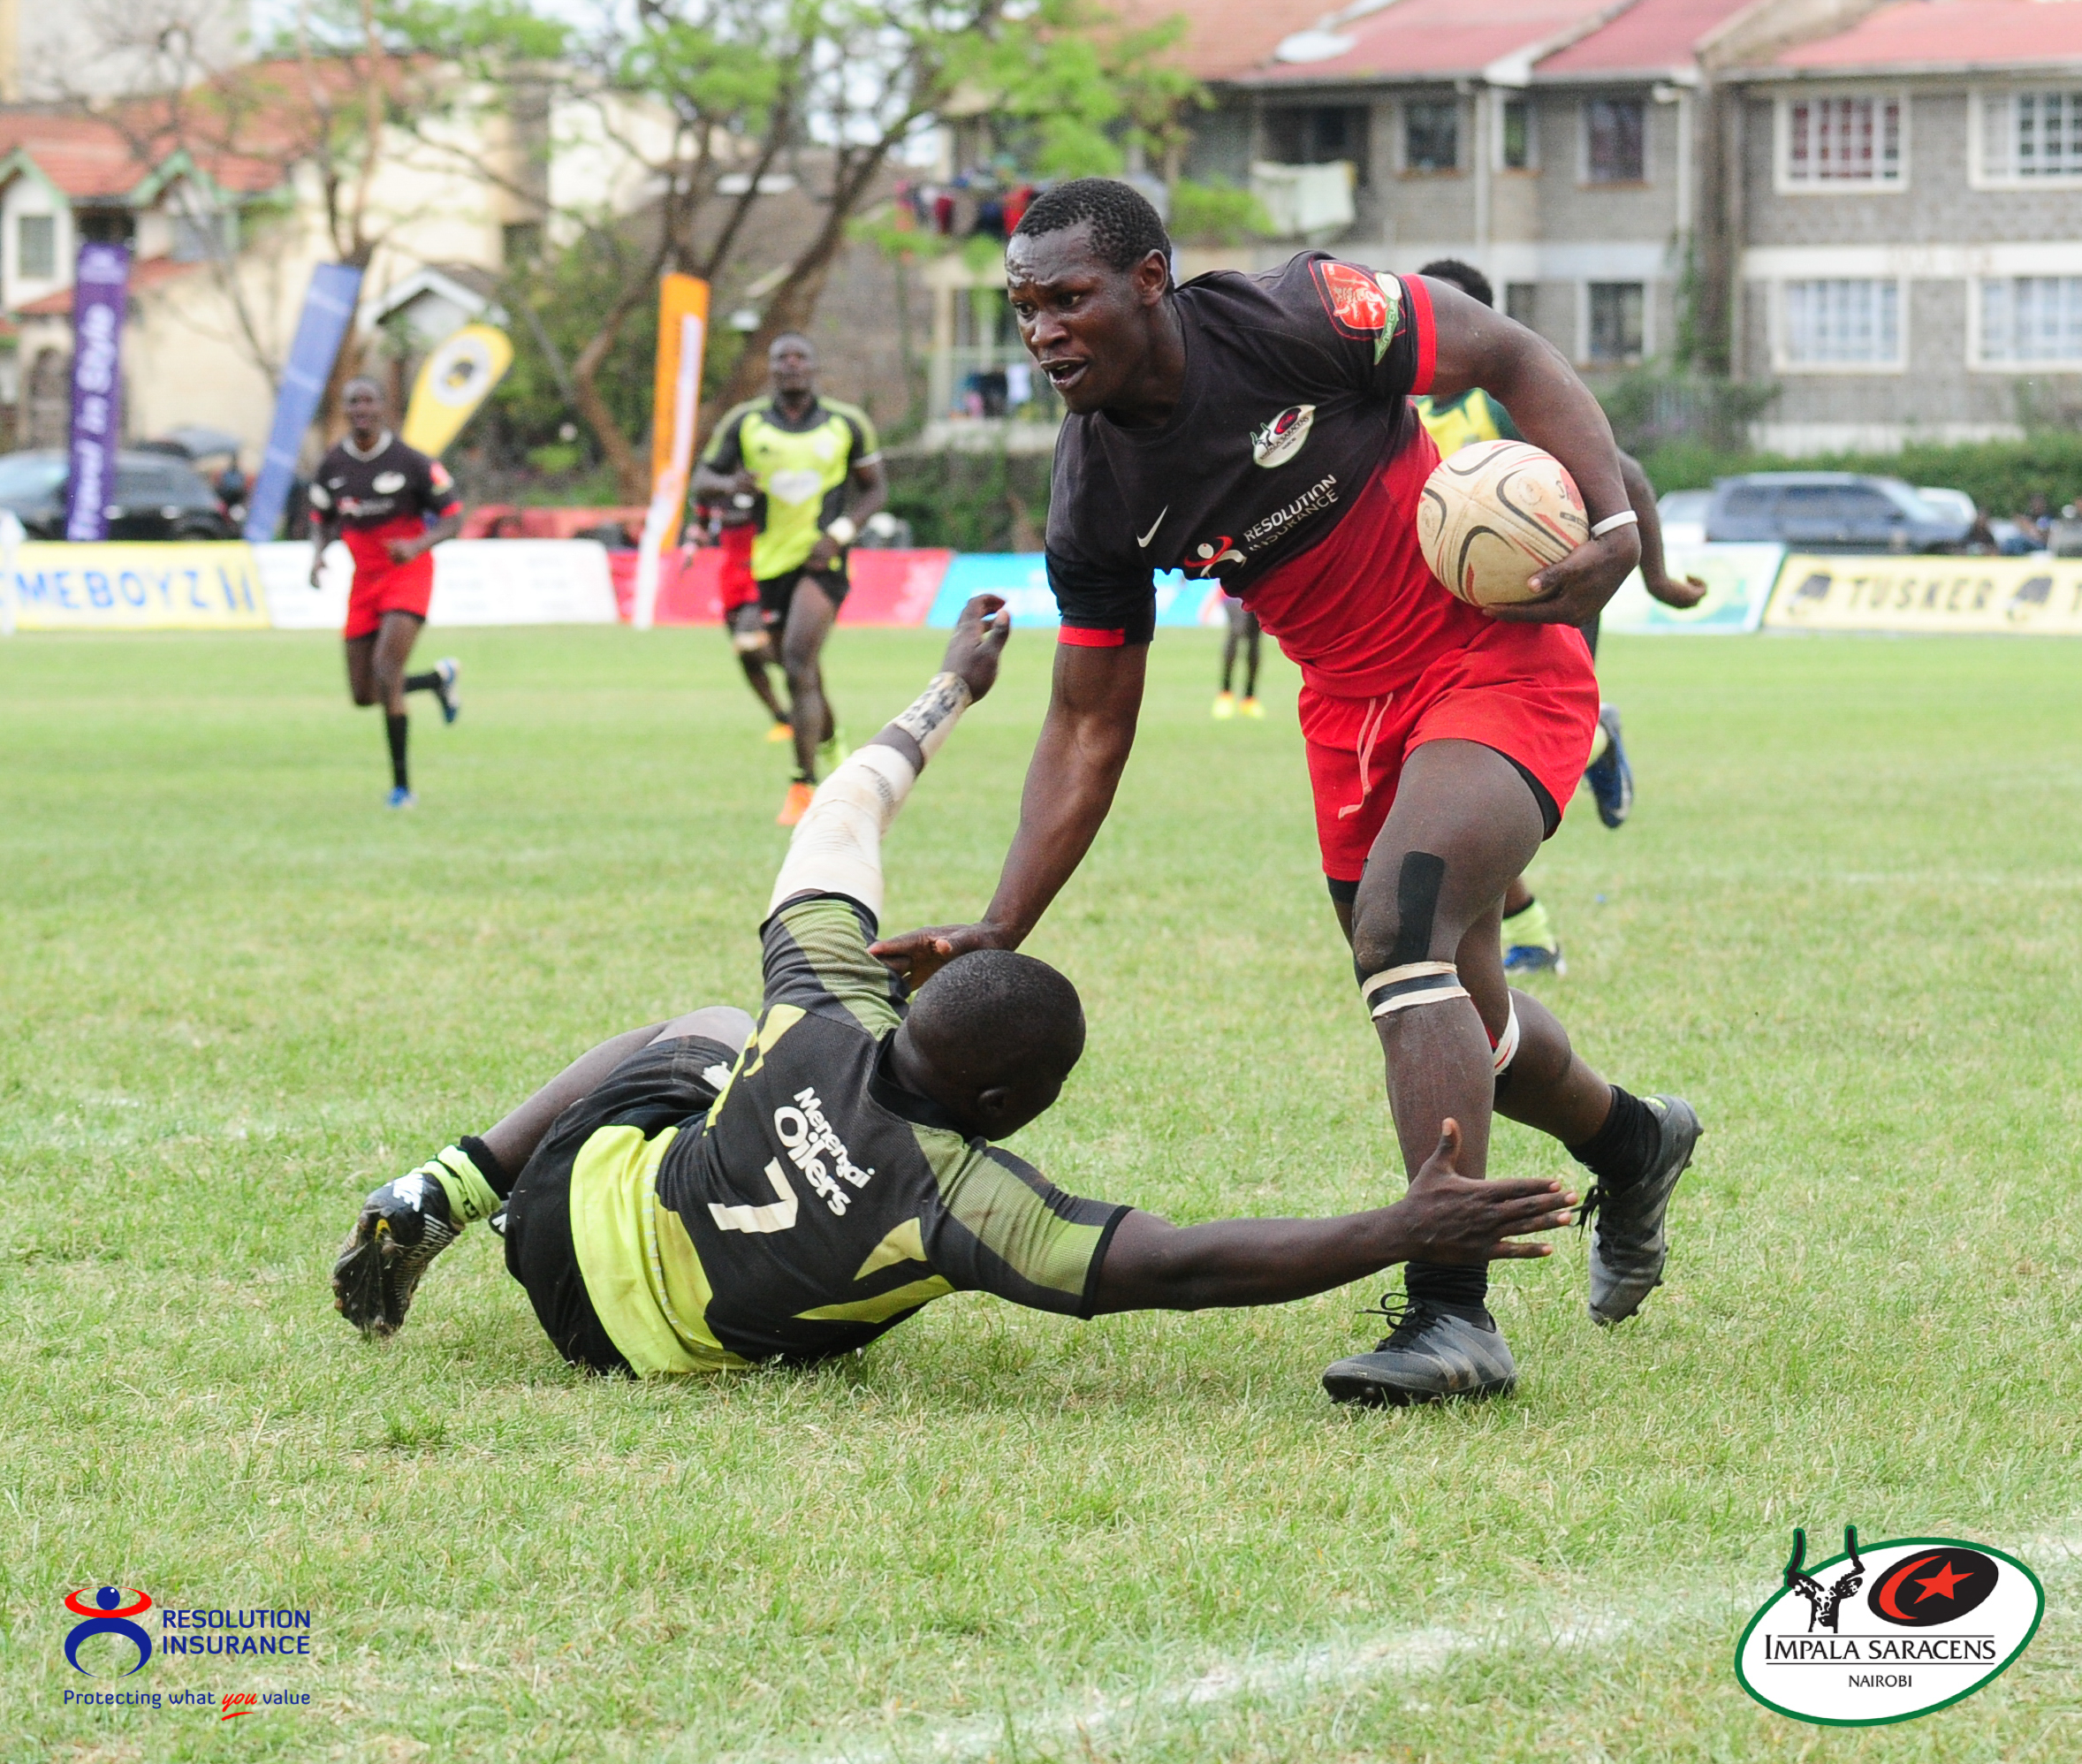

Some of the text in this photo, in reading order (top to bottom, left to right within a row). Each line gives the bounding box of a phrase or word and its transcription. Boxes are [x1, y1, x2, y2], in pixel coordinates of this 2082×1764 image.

[1242, 474, 1338, 542] RESOLUTION
[1848, 576, 1994, 612] TUSKER
[774, 1106, 852, 1216] Oilers
[793, 1086, 875, 1189] Menengai
[707, 1156, 799, 1234] 7
